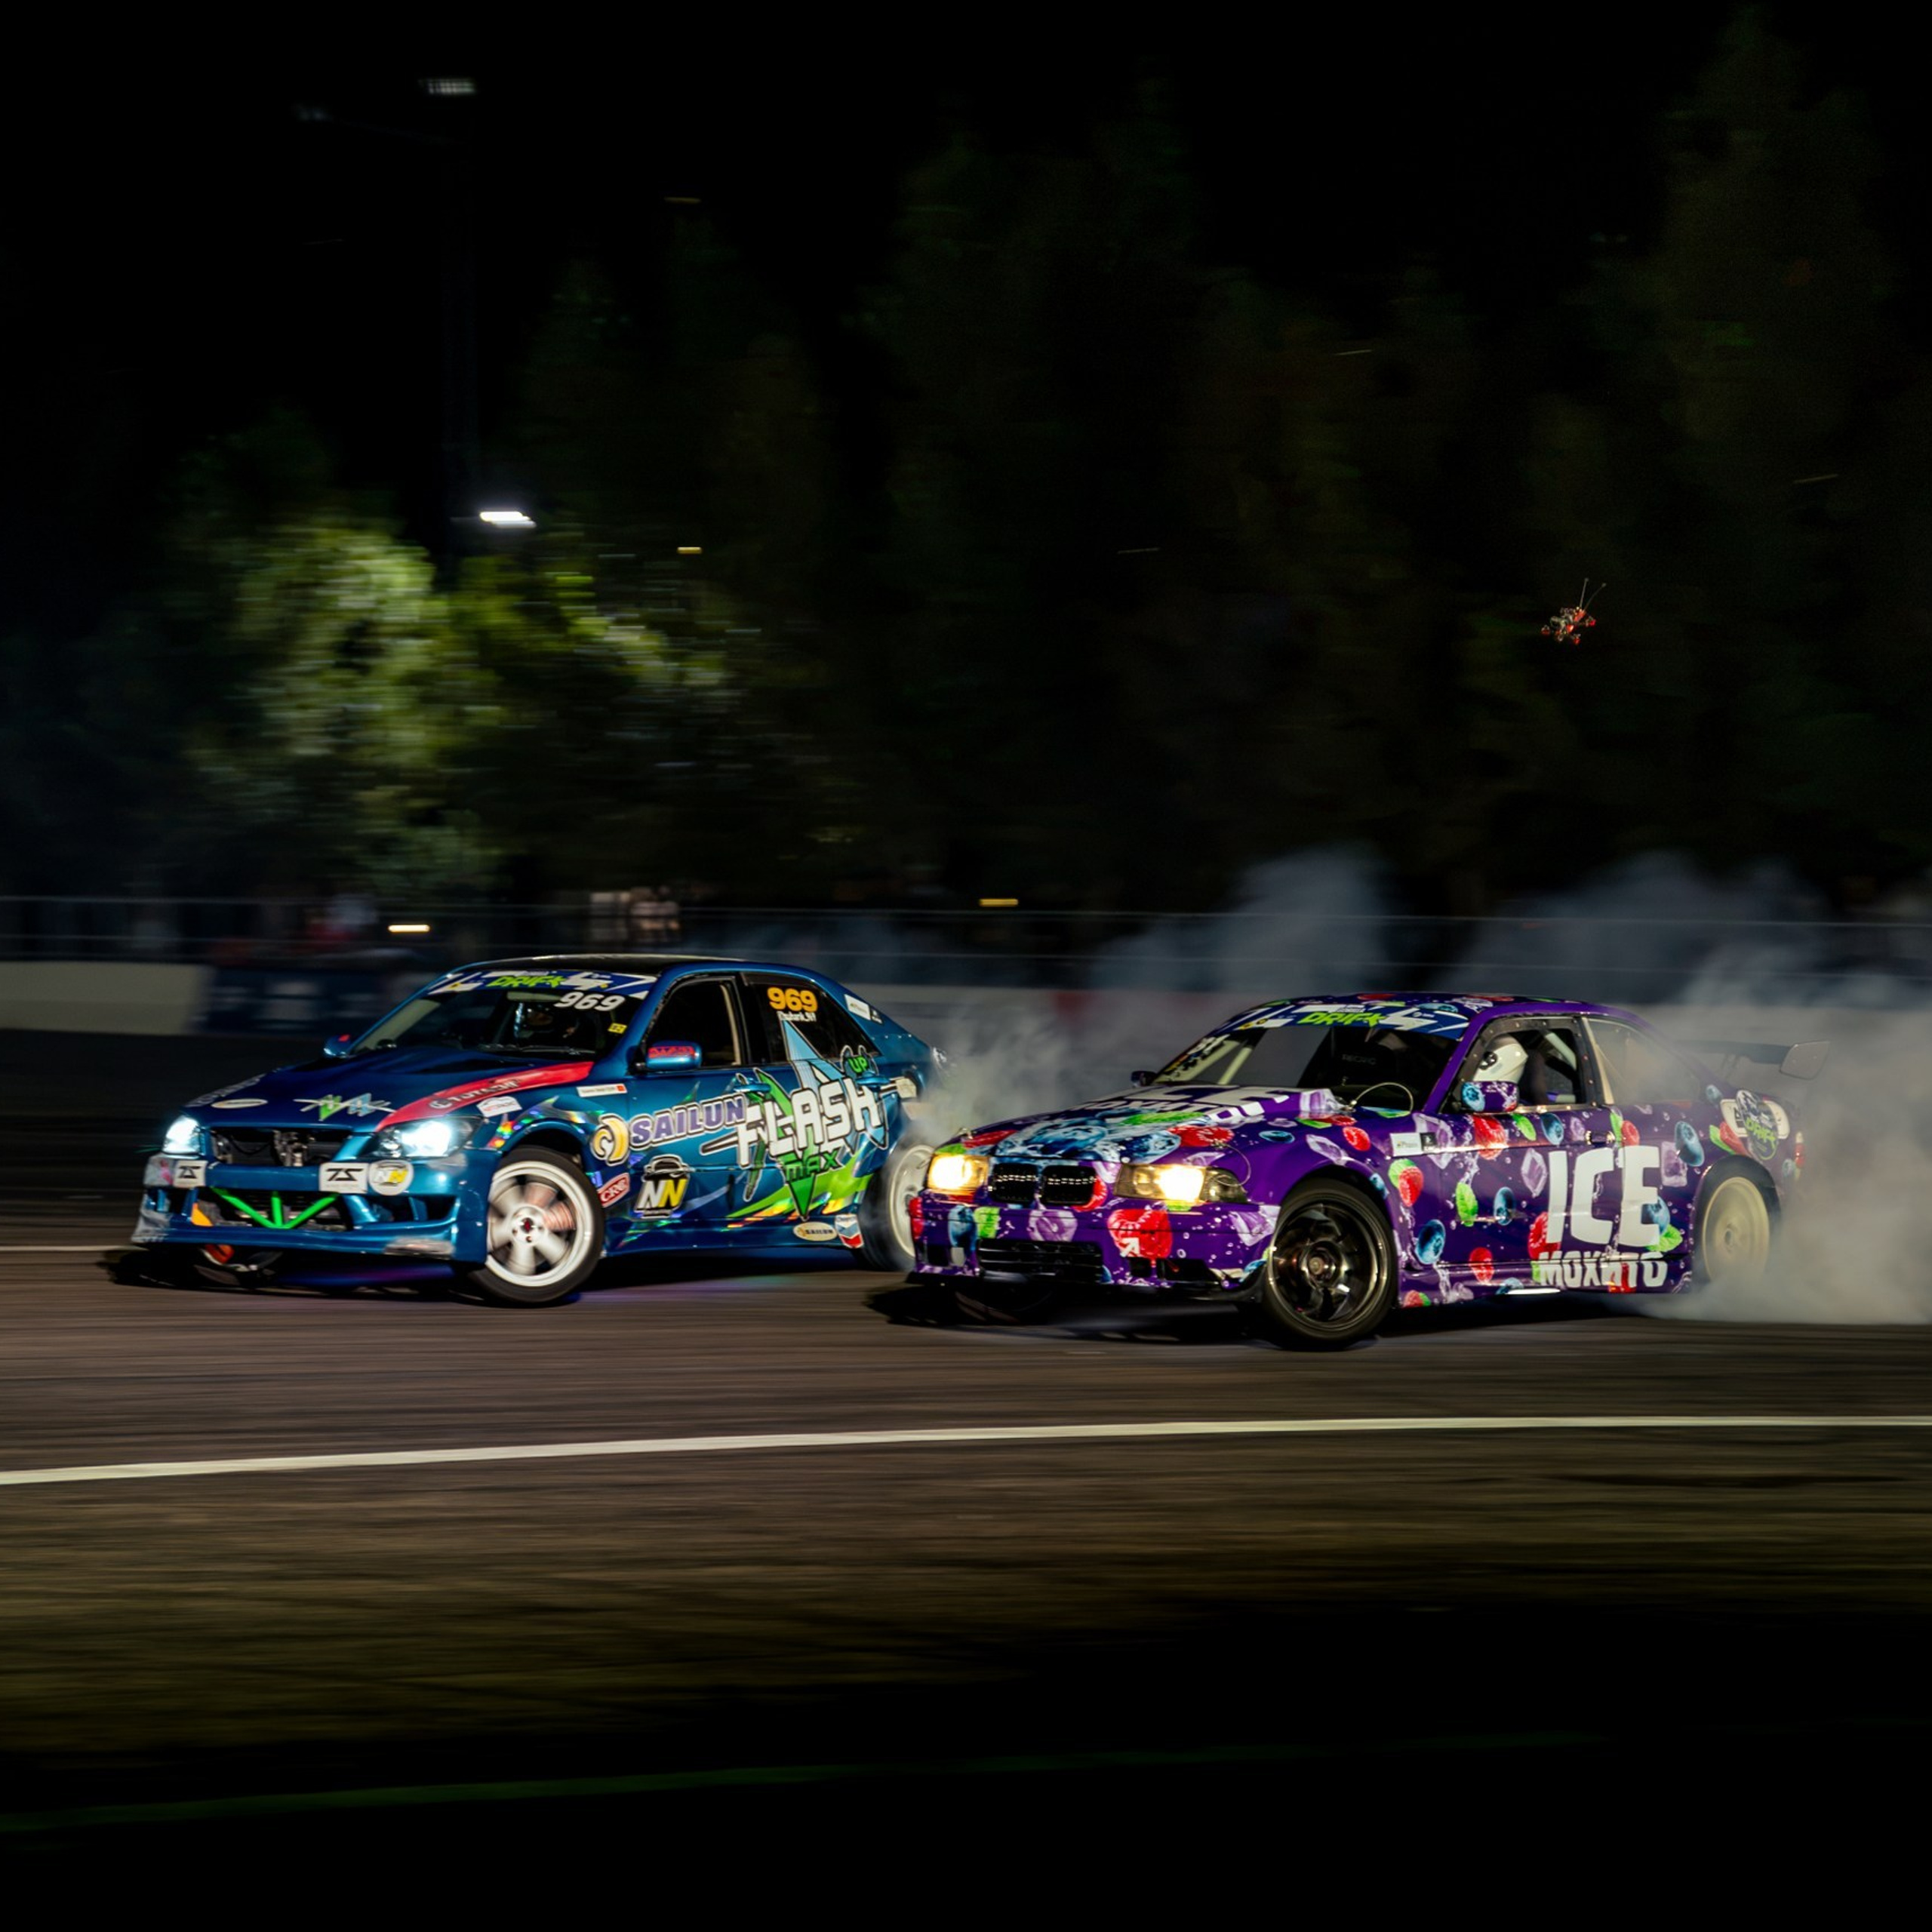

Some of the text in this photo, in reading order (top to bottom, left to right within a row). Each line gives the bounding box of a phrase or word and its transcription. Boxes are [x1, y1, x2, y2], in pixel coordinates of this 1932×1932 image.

[553, 992, 626, 1011] 969
[767, 987, 818, 1012] 969
[1297, 1012, 1387, 1027] DRIFT
[848, 1056, 868, 1073] UP
[629, 1094, 746, 1149] SAILUN
[737, 1078, 881, 1167] FLASH
[1546, 1146, 1660, 1247] ICE
